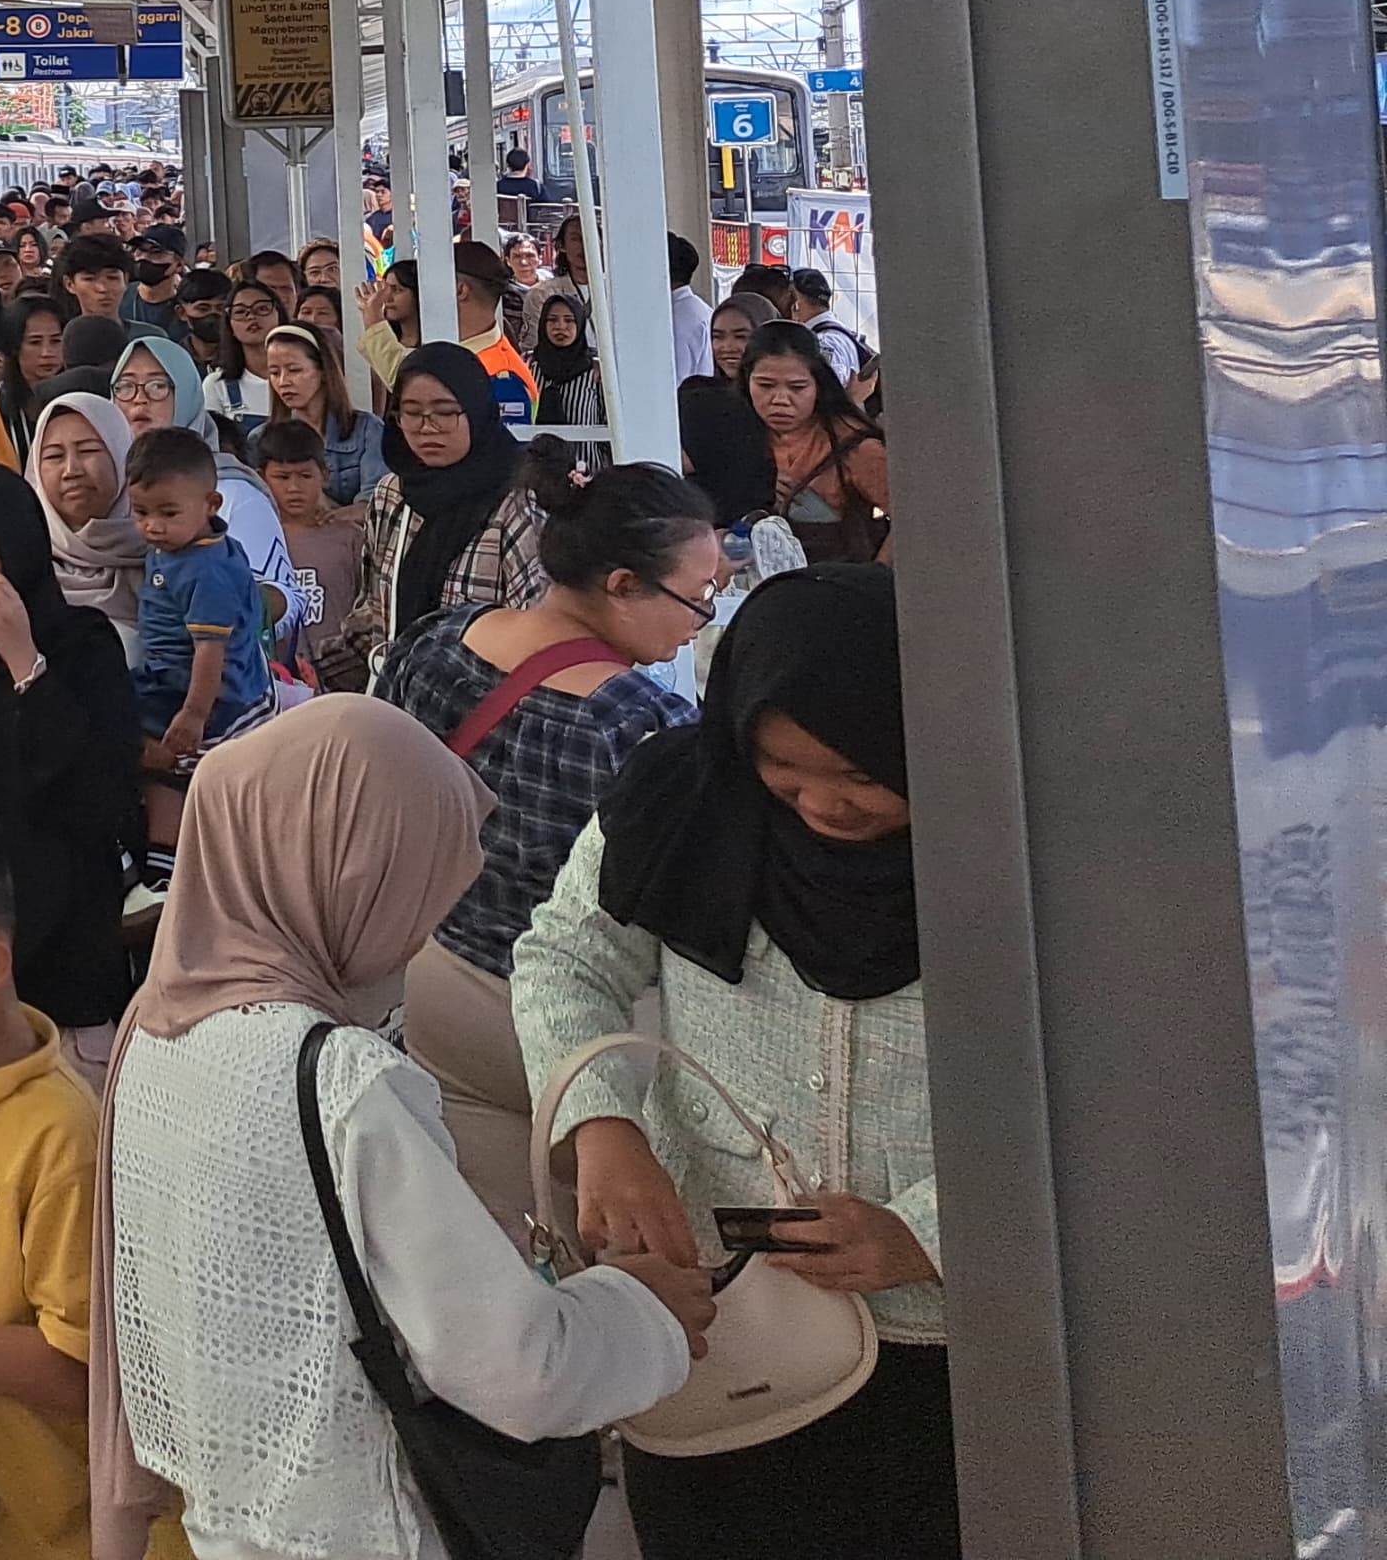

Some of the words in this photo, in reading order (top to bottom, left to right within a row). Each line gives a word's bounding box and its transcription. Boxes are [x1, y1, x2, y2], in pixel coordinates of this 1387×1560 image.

[300, 1, 330, 11] Kana
[138, 10, 180, 24] ggarai
[264, 14, 313, 23] Sebelum
[33, 55, 70, 66] Toilet
[32, 68, 73, 76] Restroom
[815, 78, 825, 89] 5
[849, 76, 860, 87] 4
[732, 114, 754, 138] 6
[809, 208, 865, 254] KAI
